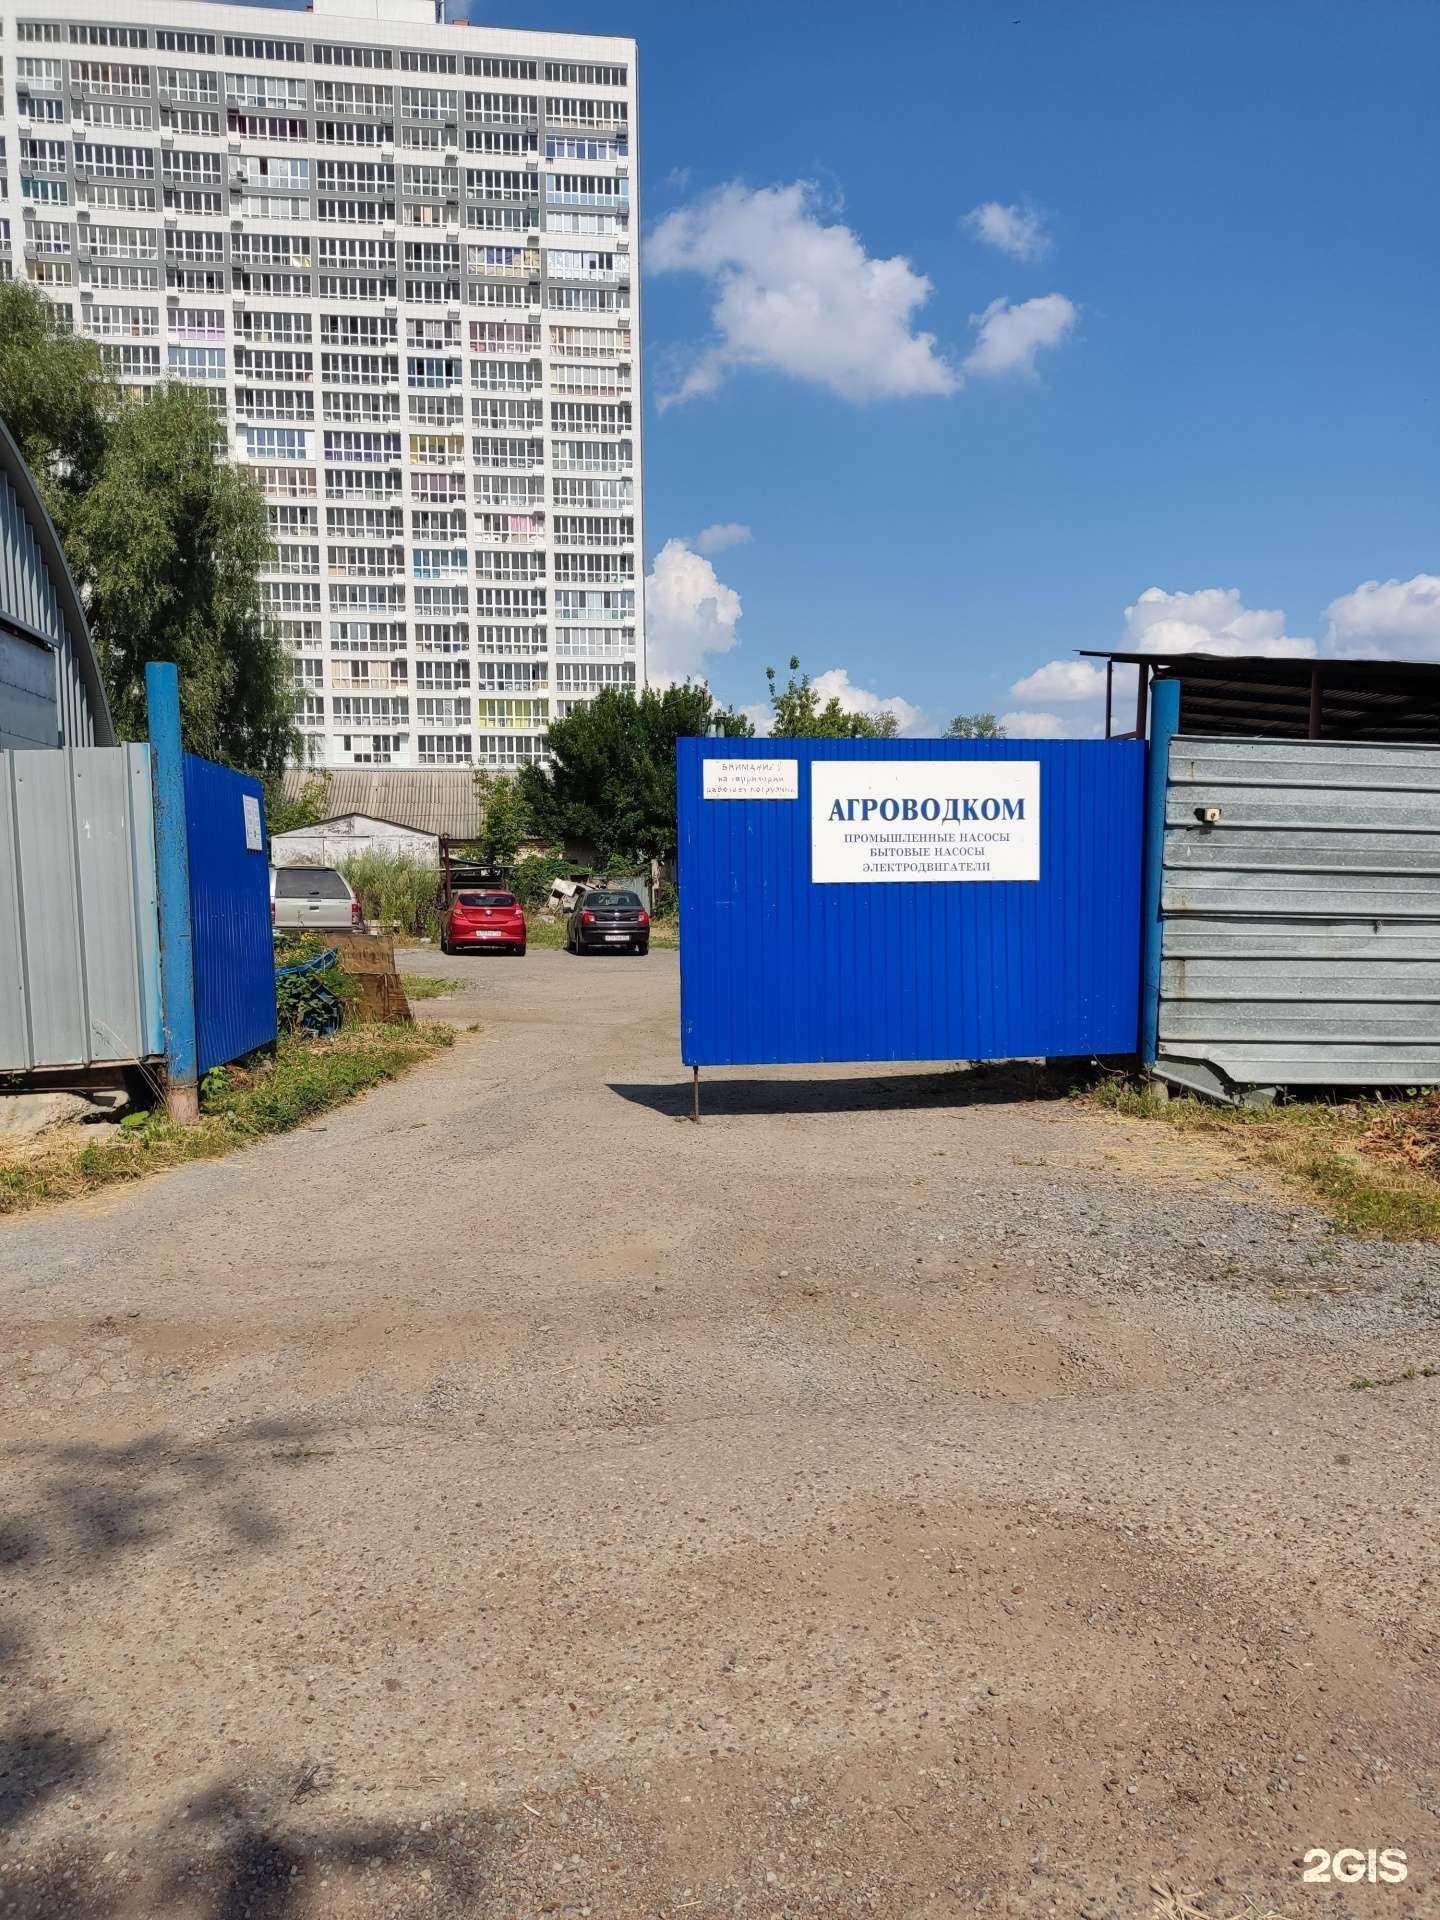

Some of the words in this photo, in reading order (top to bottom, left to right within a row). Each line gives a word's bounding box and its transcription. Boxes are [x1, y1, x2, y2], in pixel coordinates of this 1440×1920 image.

[828, 797, 1026, 826] АГРОВОДКОМ
[843, 833, 957, 844] ПРОМЫШЛЕННЫЕ
[959, 832, 1011, 843] НАСОСЫ
[869, 847, 931, 858] БЫТОВЫЕ
[934, 846, 986, 857] НАСОСЫ
[862, 861, 991, 874] ЭЛЕКТРОДВИГАТЕЛИ
